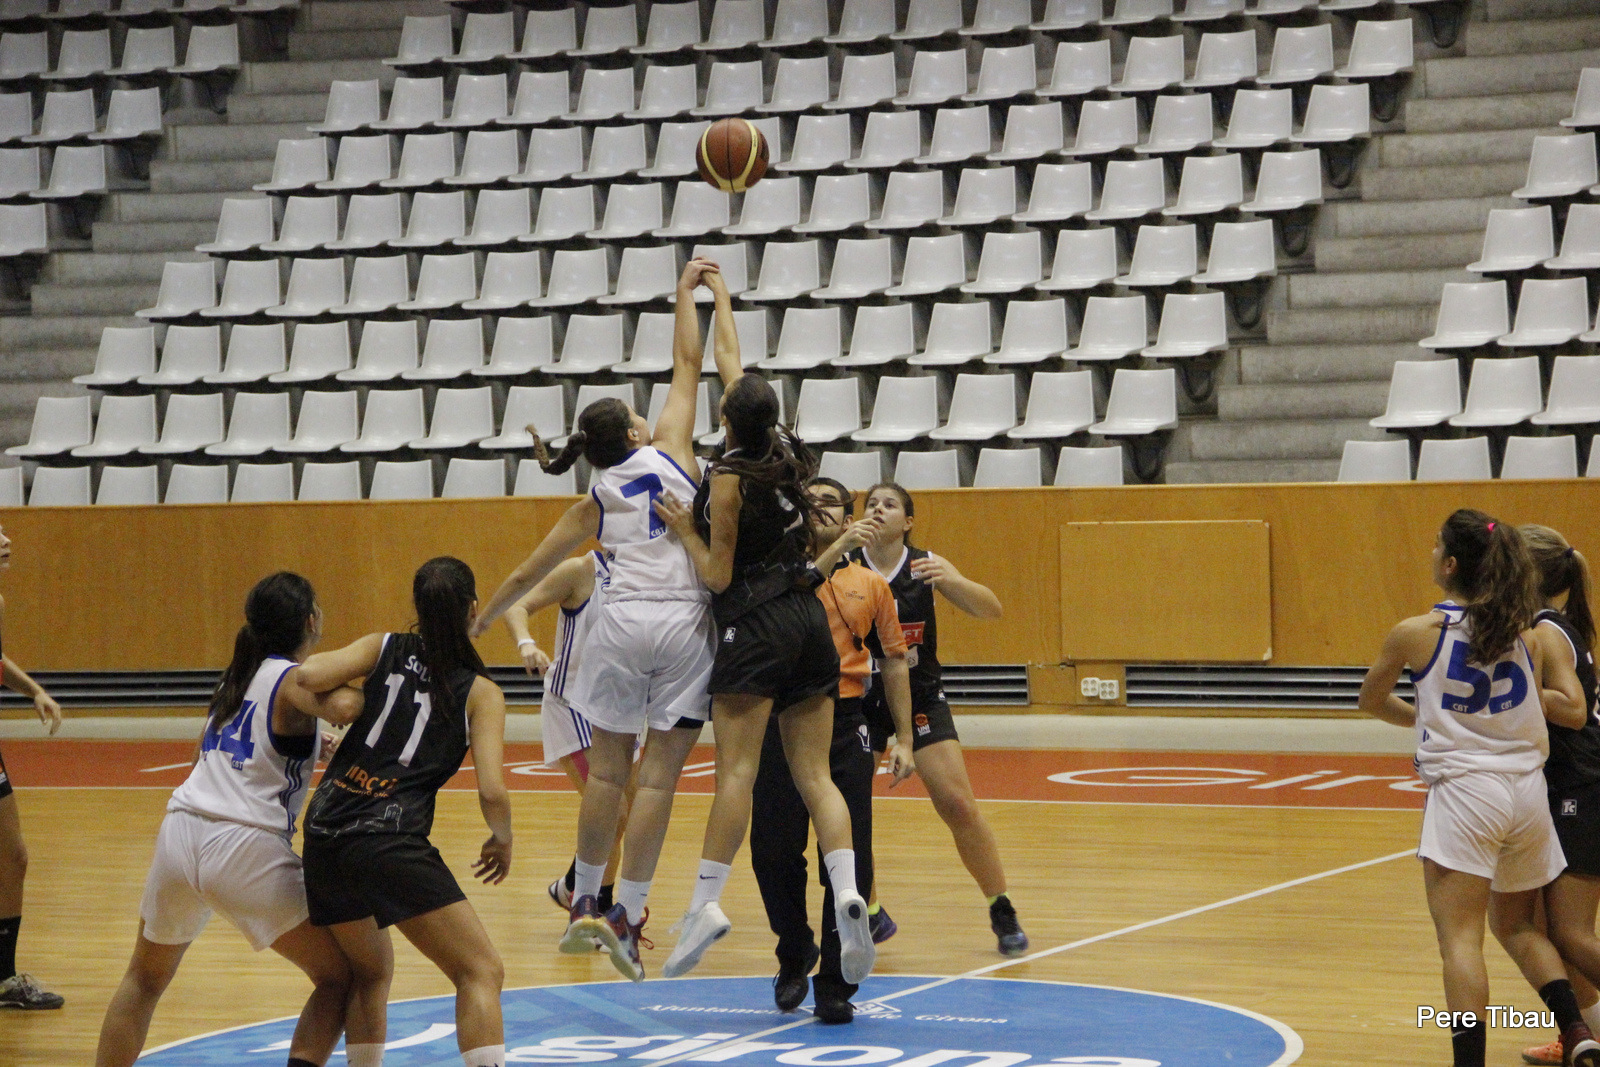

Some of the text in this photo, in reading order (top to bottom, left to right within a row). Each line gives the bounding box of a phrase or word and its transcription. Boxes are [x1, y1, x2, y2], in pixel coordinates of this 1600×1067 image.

[619, 473, 667, 540] 7
[1441, 640, 1528, 714] 55
[364, 672, 432, 768] 11
[1452, 703, 1469, 714] CBT
[1501, 700, 1513, 710] CBT
[915, 1014, 1008, 1024] Girona
